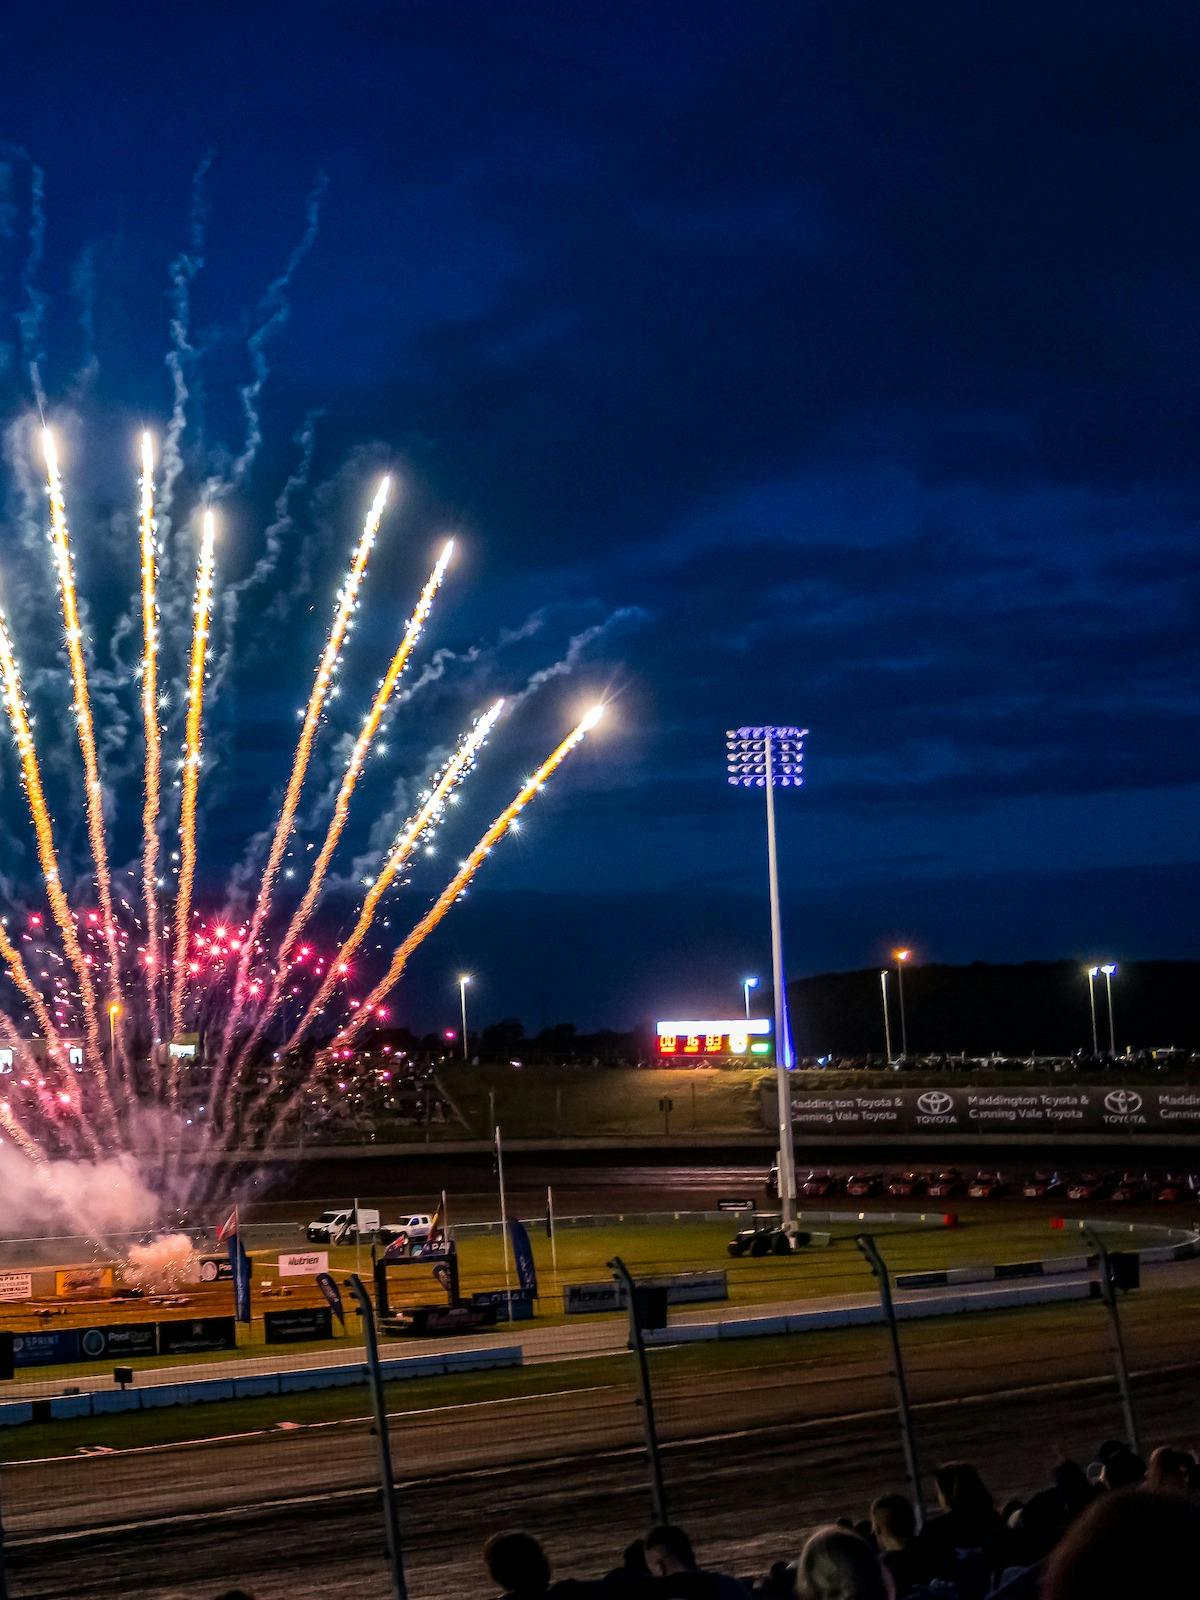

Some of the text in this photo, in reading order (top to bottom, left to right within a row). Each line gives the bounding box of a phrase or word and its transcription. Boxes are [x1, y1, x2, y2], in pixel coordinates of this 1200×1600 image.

[855, 1098, 892, 1109] Toyota
[968, 1095, 1089, 1107] Maddington Toyota &
[835, 1111, 859, 1121] Vale
[860, 1110, 897, 1122] Toyota
[916, 1116, 957, 1124] TOYOTA
[969, 1108, 1083, 1121] Canning Vale Toyota
[1103, 1115, 1146, 1124] TOYOTA
[288, 1256, 320, 1266] Nutrien
